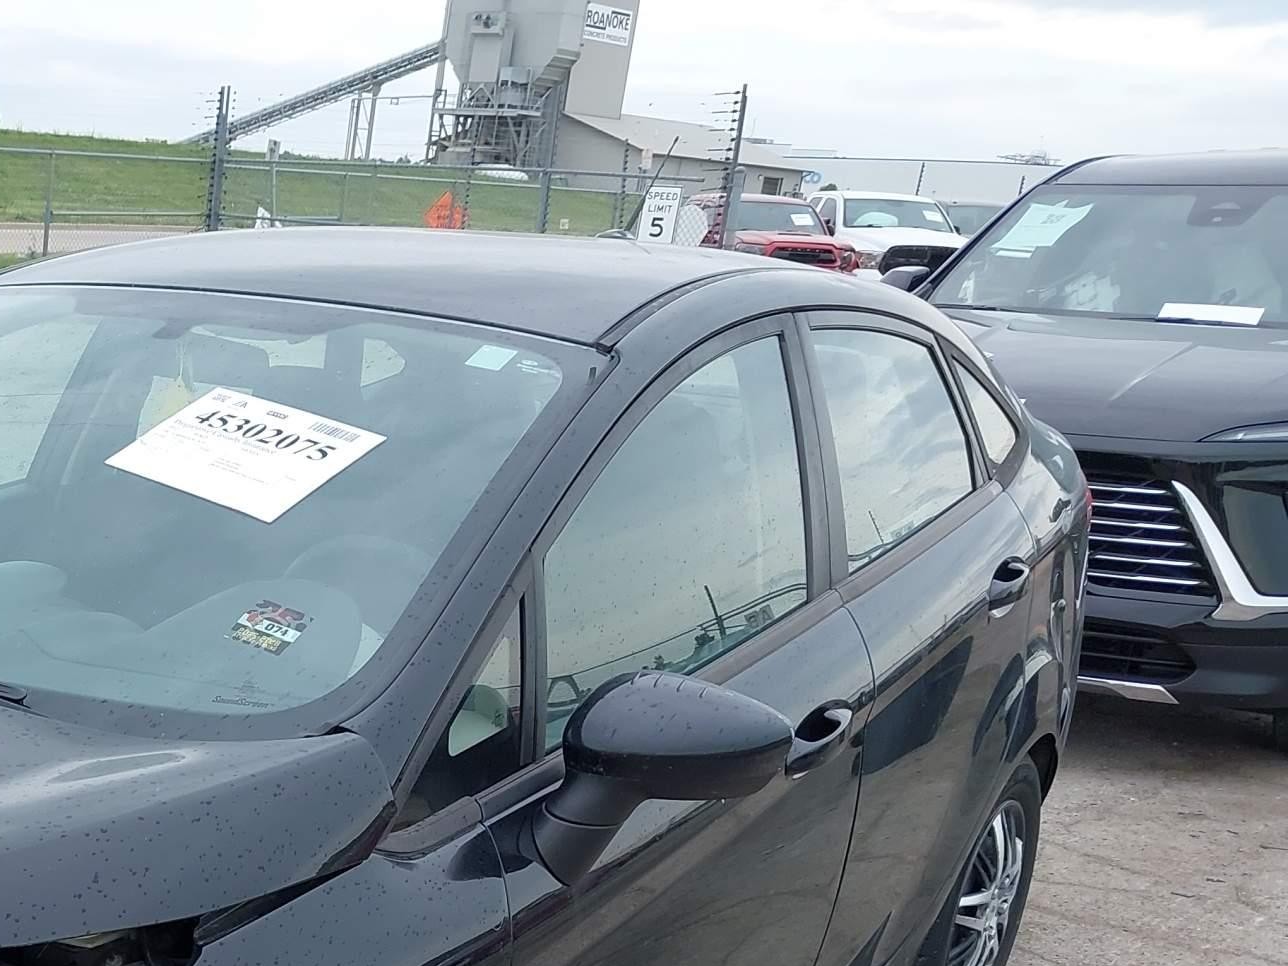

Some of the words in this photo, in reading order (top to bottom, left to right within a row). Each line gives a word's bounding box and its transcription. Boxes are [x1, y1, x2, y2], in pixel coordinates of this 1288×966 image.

[586, 10, 631, 31] ROANOKE
[647, 191, 679, 201] SPEED
[647, 204, 673, 214] LIMIT
[648, 217, 664, 238] 5
[195, 411, 337, 460] 45302075
[264, 623, 289, 637] 074
